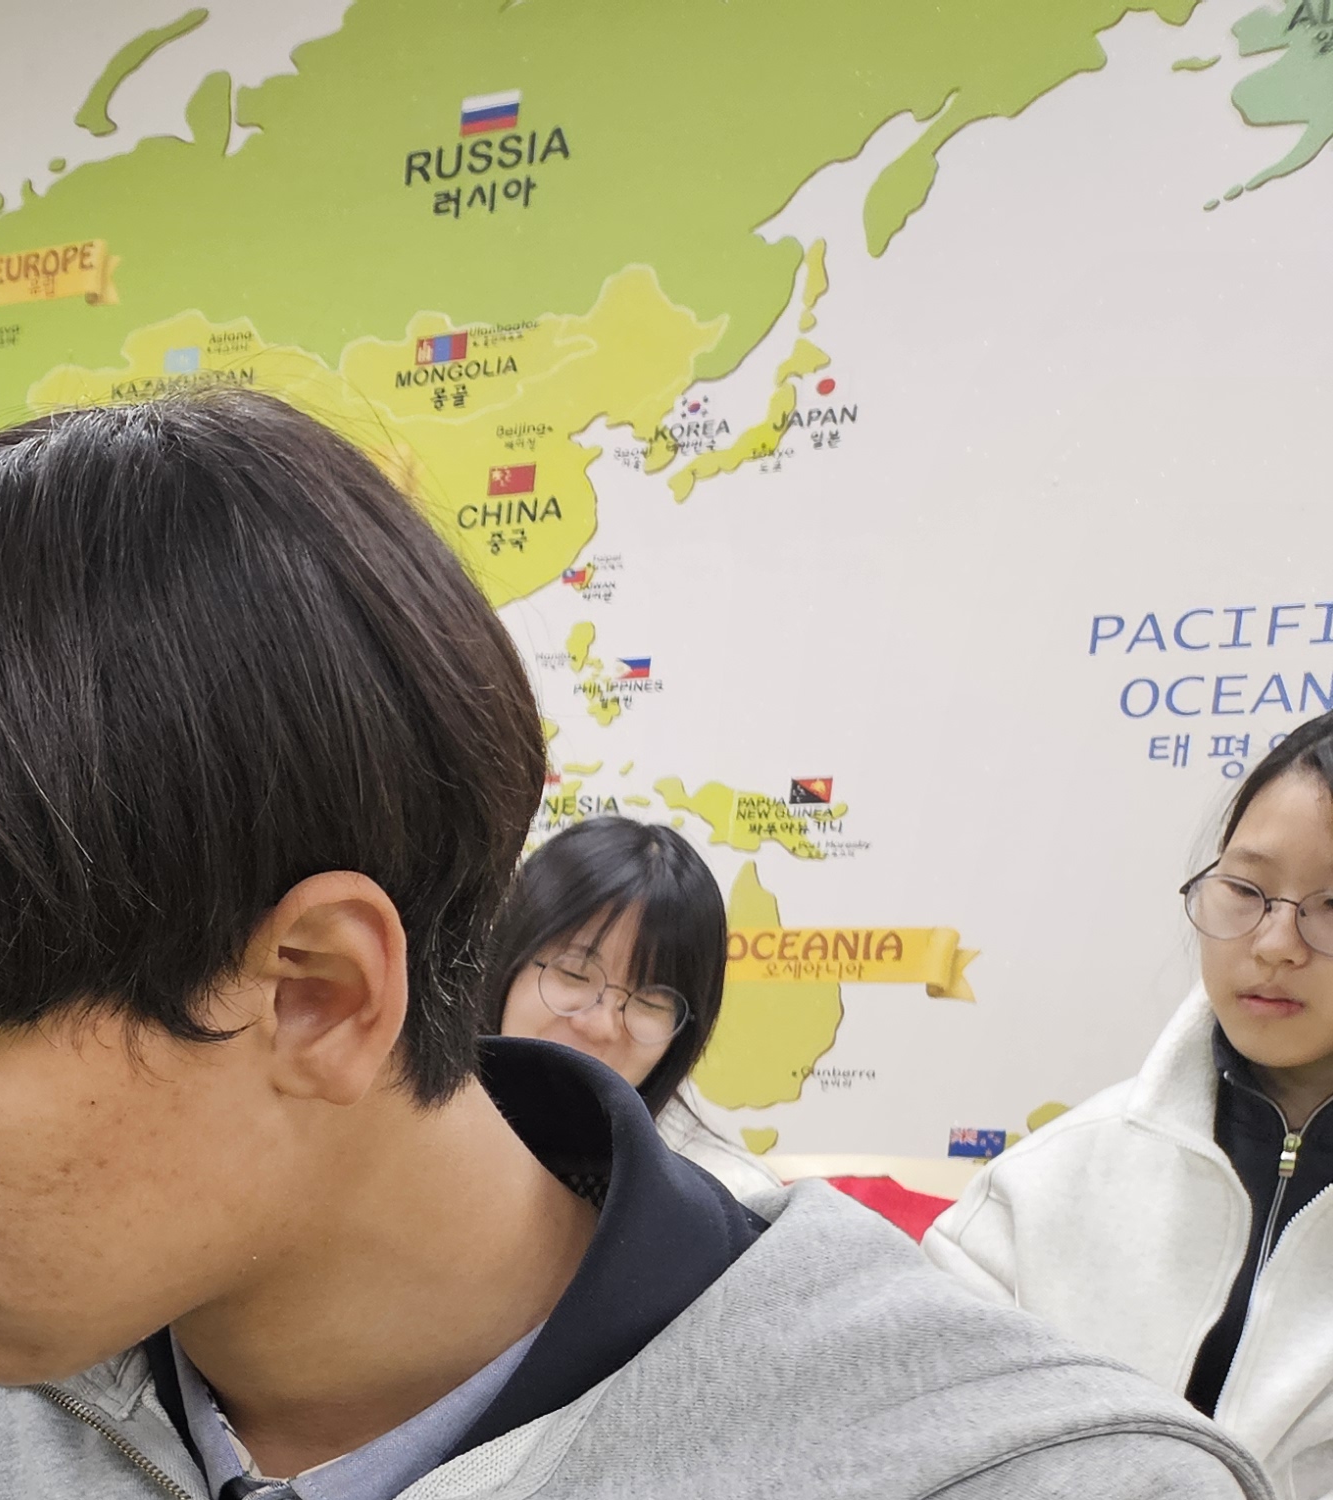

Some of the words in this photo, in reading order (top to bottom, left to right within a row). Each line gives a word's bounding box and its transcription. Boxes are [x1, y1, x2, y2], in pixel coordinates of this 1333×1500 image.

[405, 125, 570, 186] RUSSIA
[433, 175, 539, 219] 러시아
[395, 355, 518, 388] MONGOLIA
[430, 384, 469, 412] 몽골
[496, 421, 546, 439] Beijing
[653, 418, 731, 442] KOREA
[773, 404, 858, 432] JAPAN
[810, 429, 842, 450] 일본
[457, 494, 562, 530] CHINA
[487, 528, 528, 556] 중국
[573, 679, 665, 695] PHILIPPINES
[1119, 671, 1333, 719] OCEAN
[541, 794, 620, 817] NESIA
[736, 808, 770, 821] NEW
[775, 806, 834, 820] GUINEA
[737, 796, 787, 809] PAPUA
[727, 929, 904, 962] OCEANIA
[761, 961, 865, 980] 오세아니아
